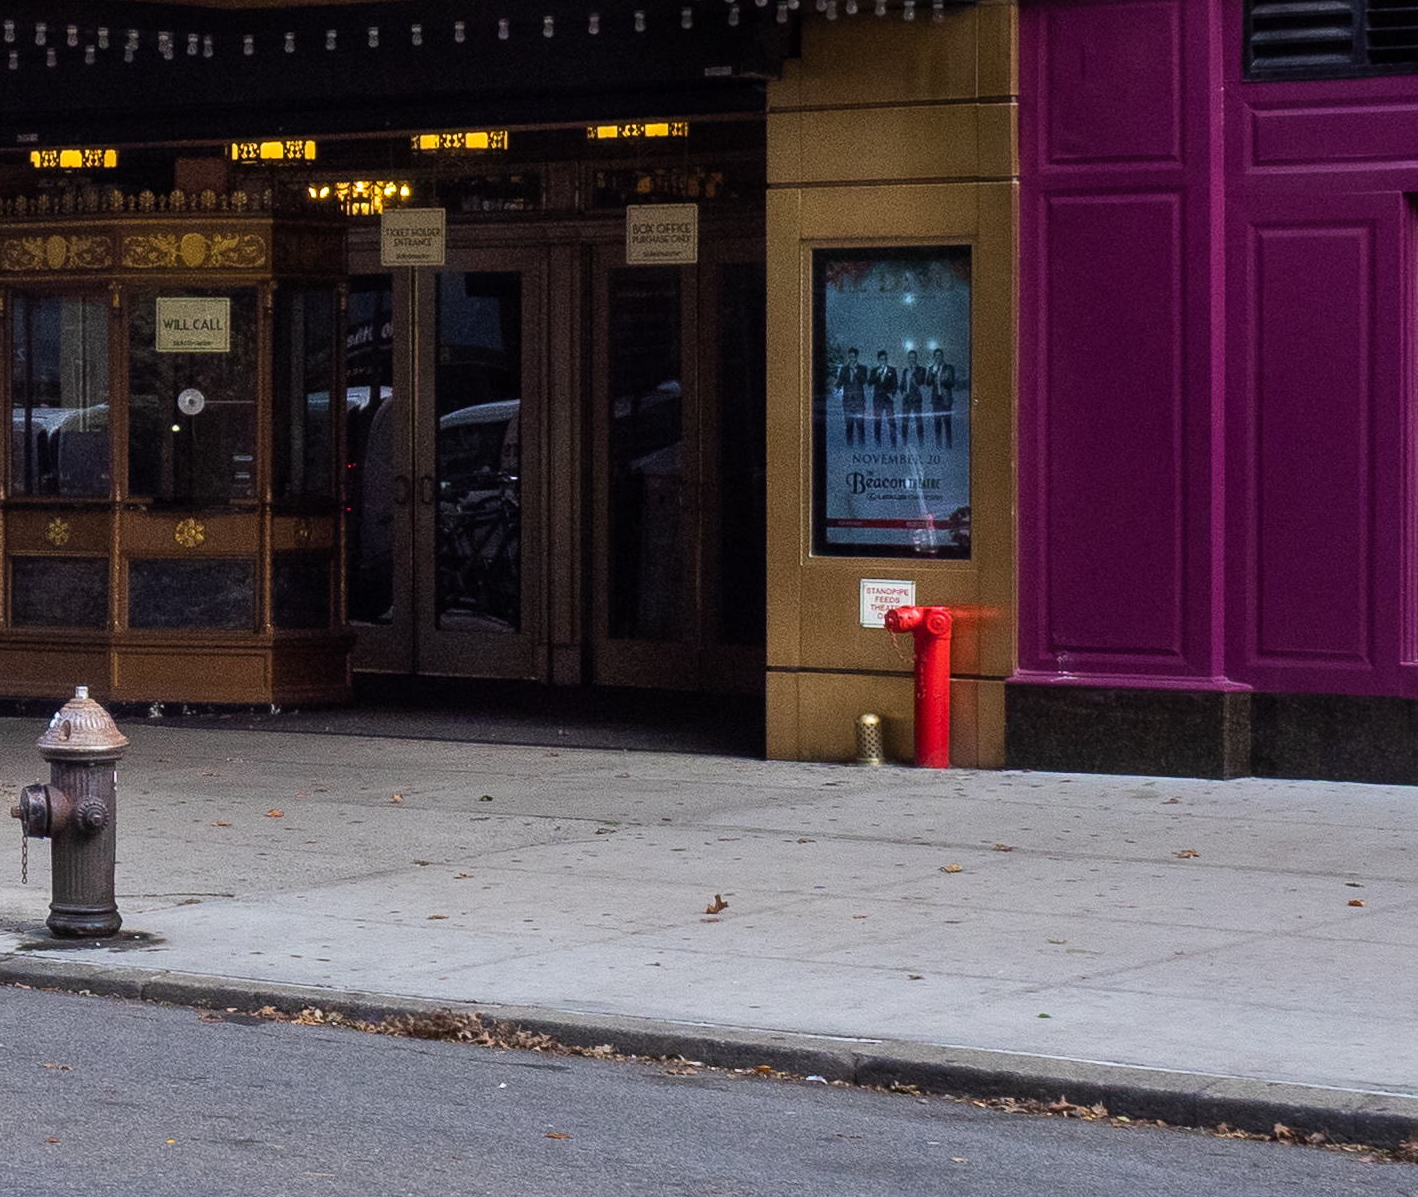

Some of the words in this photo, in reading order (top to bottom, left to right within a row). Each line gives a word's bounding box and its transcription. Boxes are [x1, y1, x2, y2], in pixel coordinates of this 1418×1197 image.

[632, 224, 655, 234] BOX
[656, 223, 692, 234] OFFICE
[163, 319, 189, 330] WILL
[193, 319, 223, 331] CALL
[852, 454, 923, 464] NOVEMBER
[927, 454, 941, 464] 20
[866, 587, 909, 597] STANDPIPE
[875, 595, 901, 604] FEEDS
